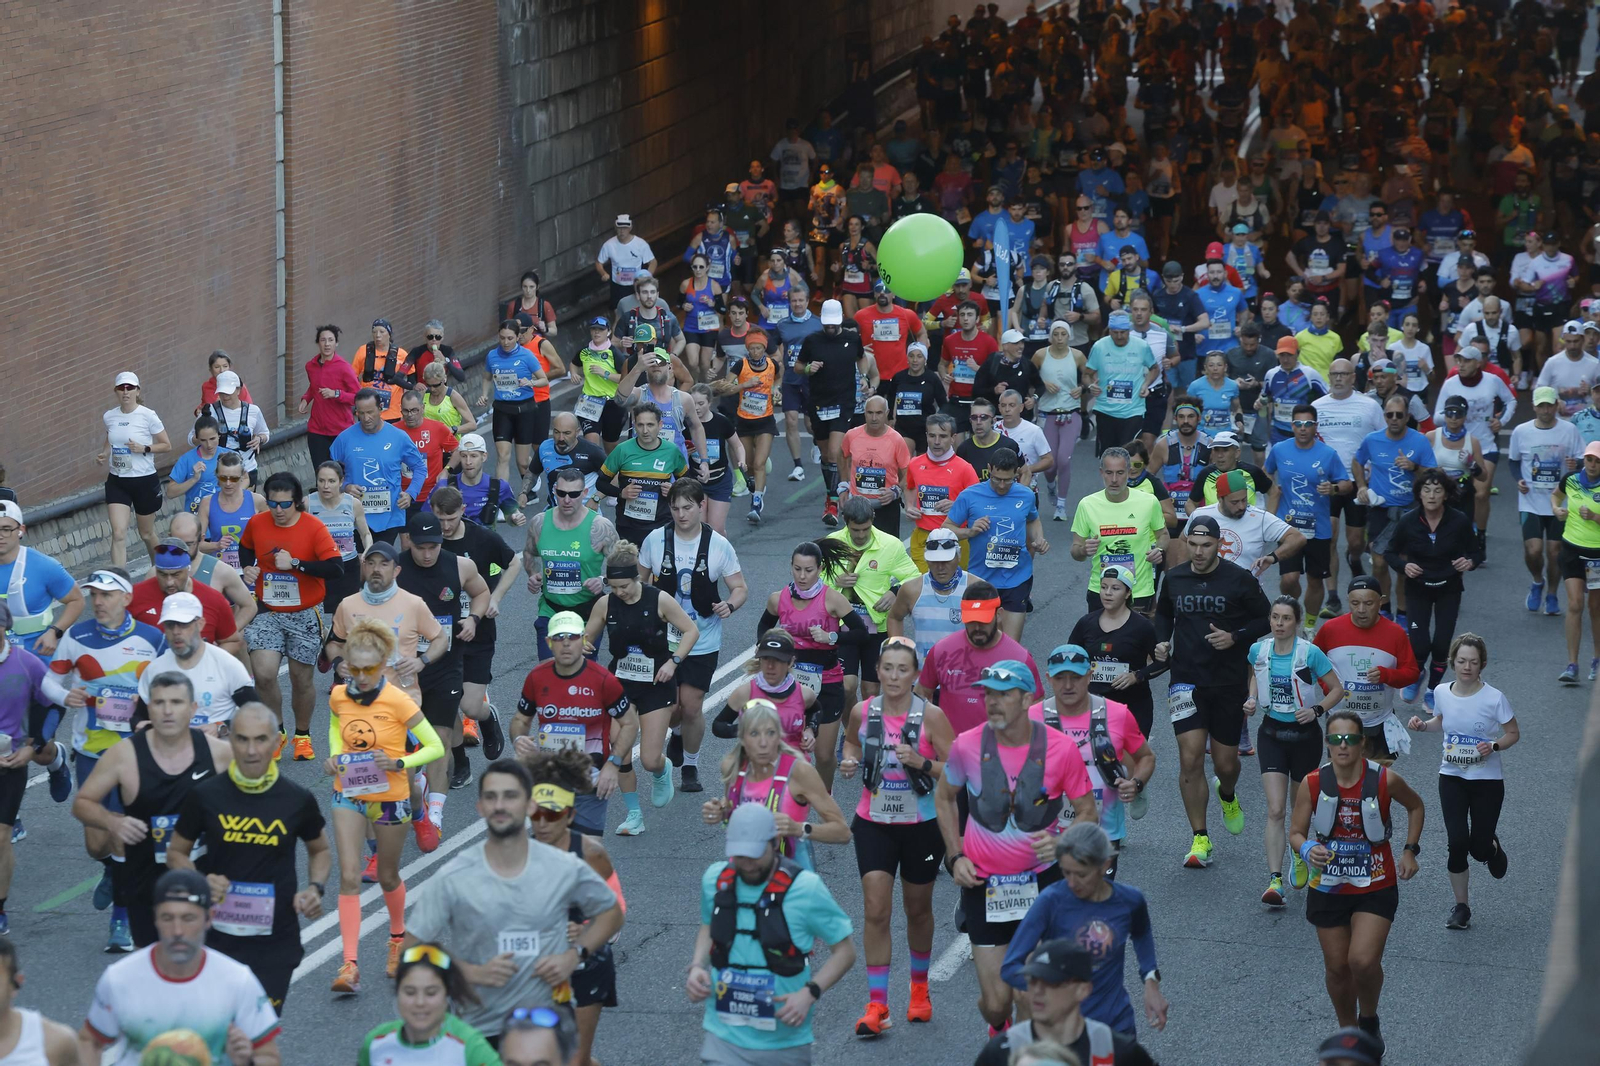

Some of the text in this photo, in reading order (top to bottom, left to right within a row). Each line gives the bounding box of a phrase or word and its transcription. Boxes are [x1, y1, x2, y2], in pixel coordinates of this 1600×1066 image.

[628, 504, 652, 514] RICARDO
[1100, 527, 1137, 536] MARATHON
[540, 550, 581, 558] IRELAND
[985, 552, 1020, 561] MORLANEZ
[271, 591, 290, 599] JHON
[1174, 595, 1227, 613] ASICS
[618, 662, 651, 673] ANNABEL
[1346, 701, 1372, 711] JORGE
[559, 706, 602, 718] addiction
[347, 773, 379, 786] NIEVES
[884, 794, 903, 802] 12432
[881, 803, 905, 813] JANE
[223, 831, 279, 846] ULTRA
[1326, 864, 1367, 877] YOLANDA
[1000, 873, 1031, 884] ZURICH
[234, 885, 270, 895] ZURICH
[1002, 888, 1021, 897] 11444
[734, 974, 769, 986] ZURICH
[729, 1001, 759, 1017] DAVE
